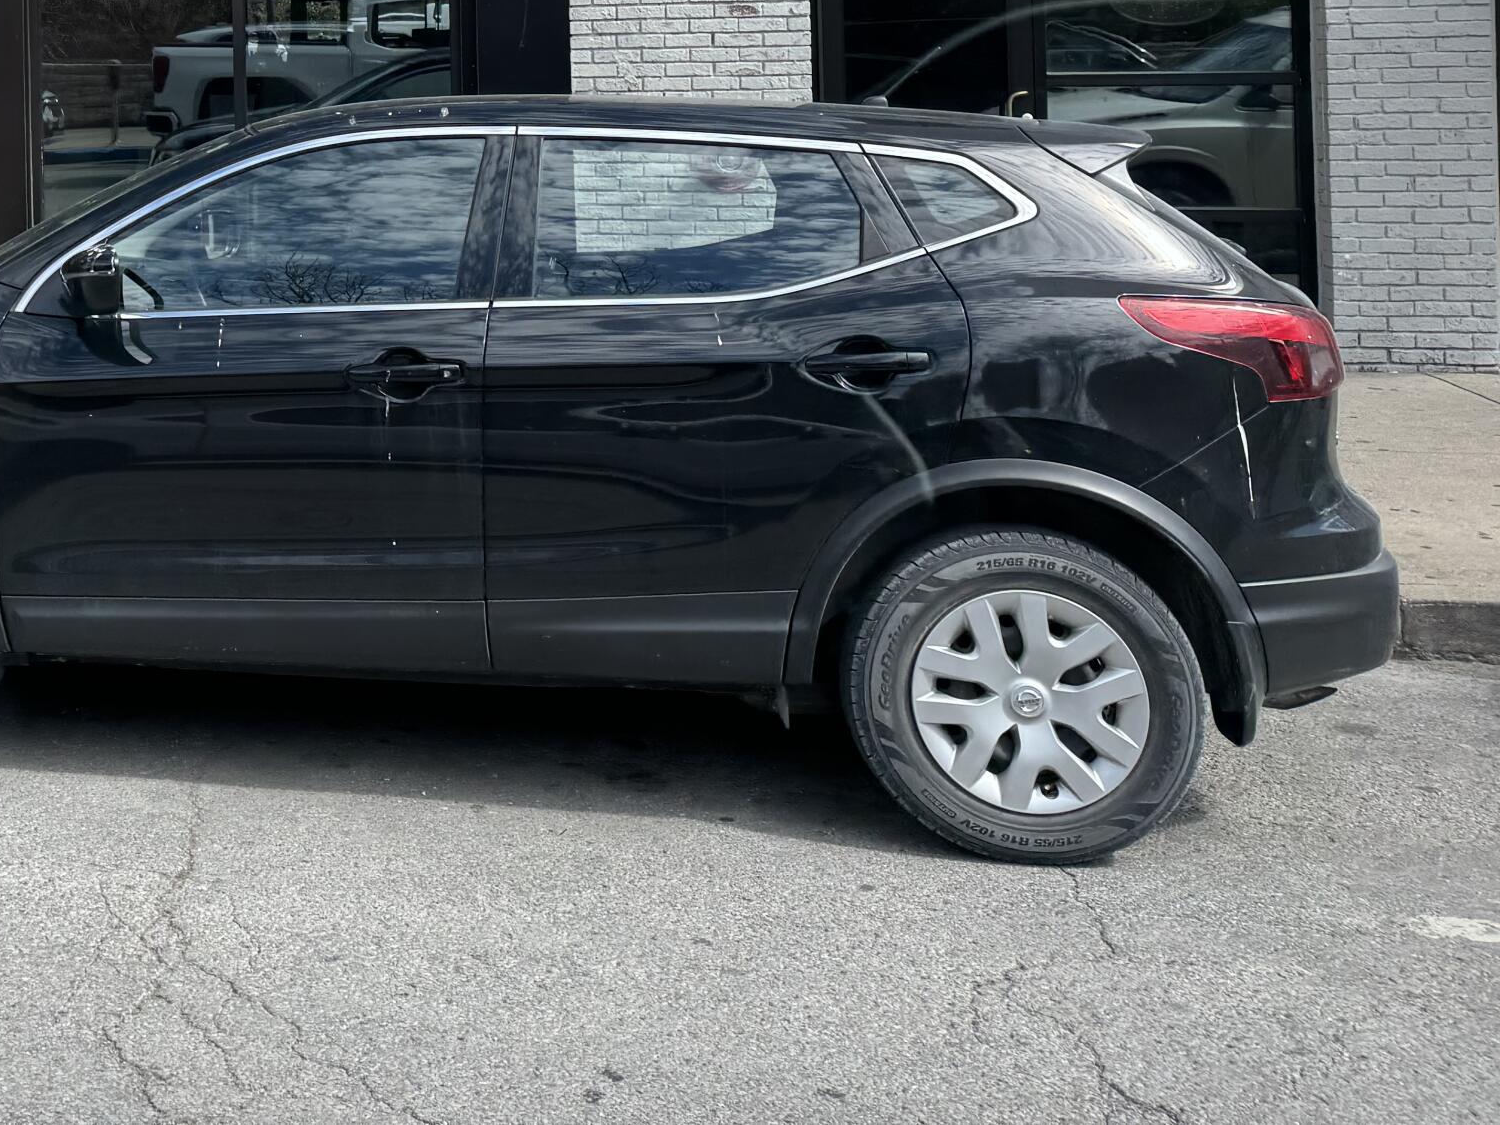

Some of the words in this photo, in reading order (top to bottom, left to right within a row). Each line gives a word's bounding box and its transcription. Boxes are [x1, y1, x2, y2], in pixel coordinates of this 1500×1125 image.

[1027, 557, 1057, 571] R16
[1060, 564, 1098, 585] 102V
[960, 818, 996, 839] 102V
[1000, 834, 1030, 847] R16
